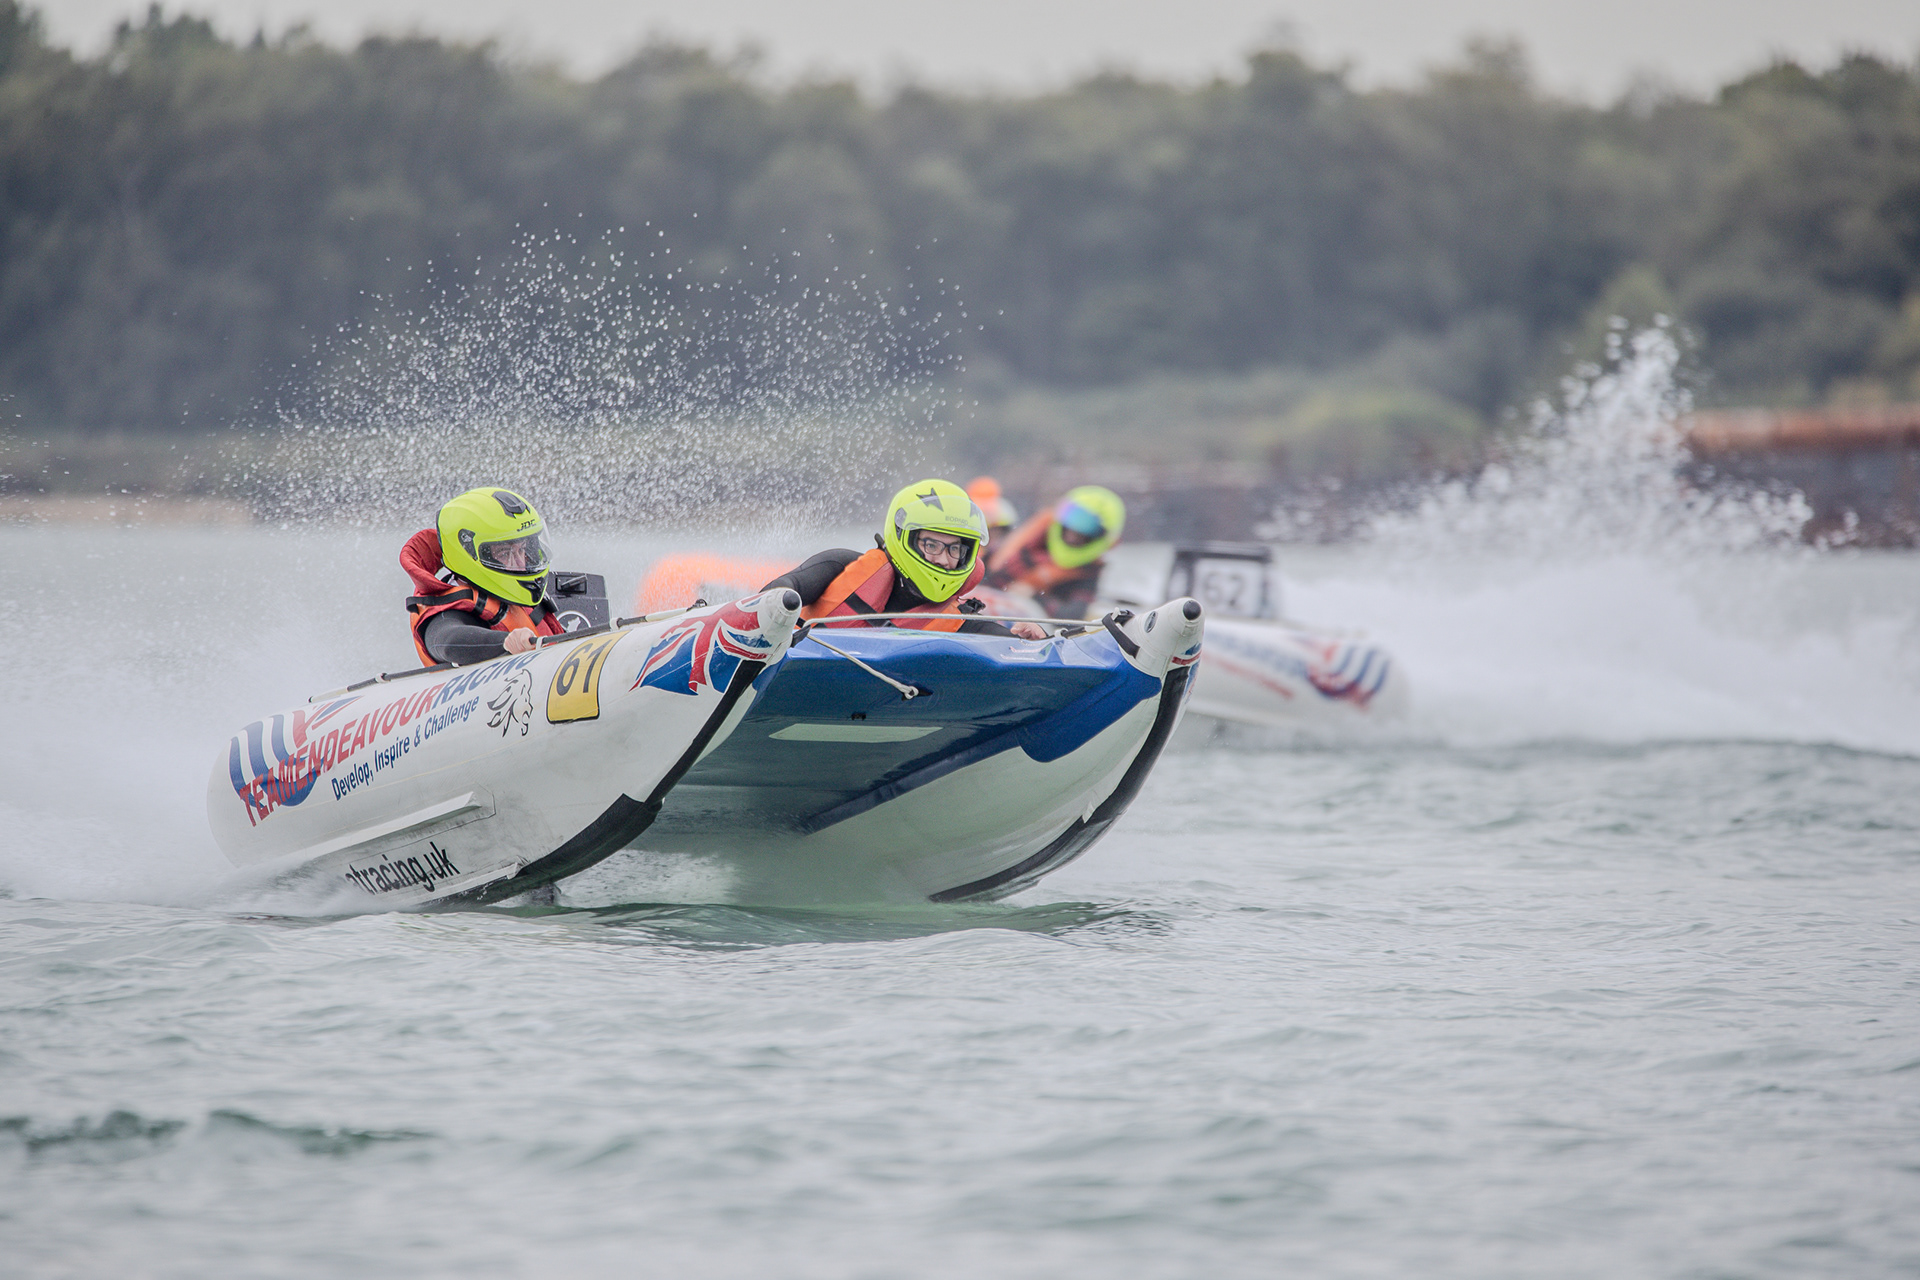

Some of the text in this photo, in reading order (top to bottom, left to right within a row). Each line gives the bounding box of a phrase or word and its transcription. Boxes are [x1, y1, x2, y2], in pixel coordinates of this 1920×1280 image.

[556, 639, 612, 697] 61
[331, 695, 480, 801] Develop, Inspire & Challenge
